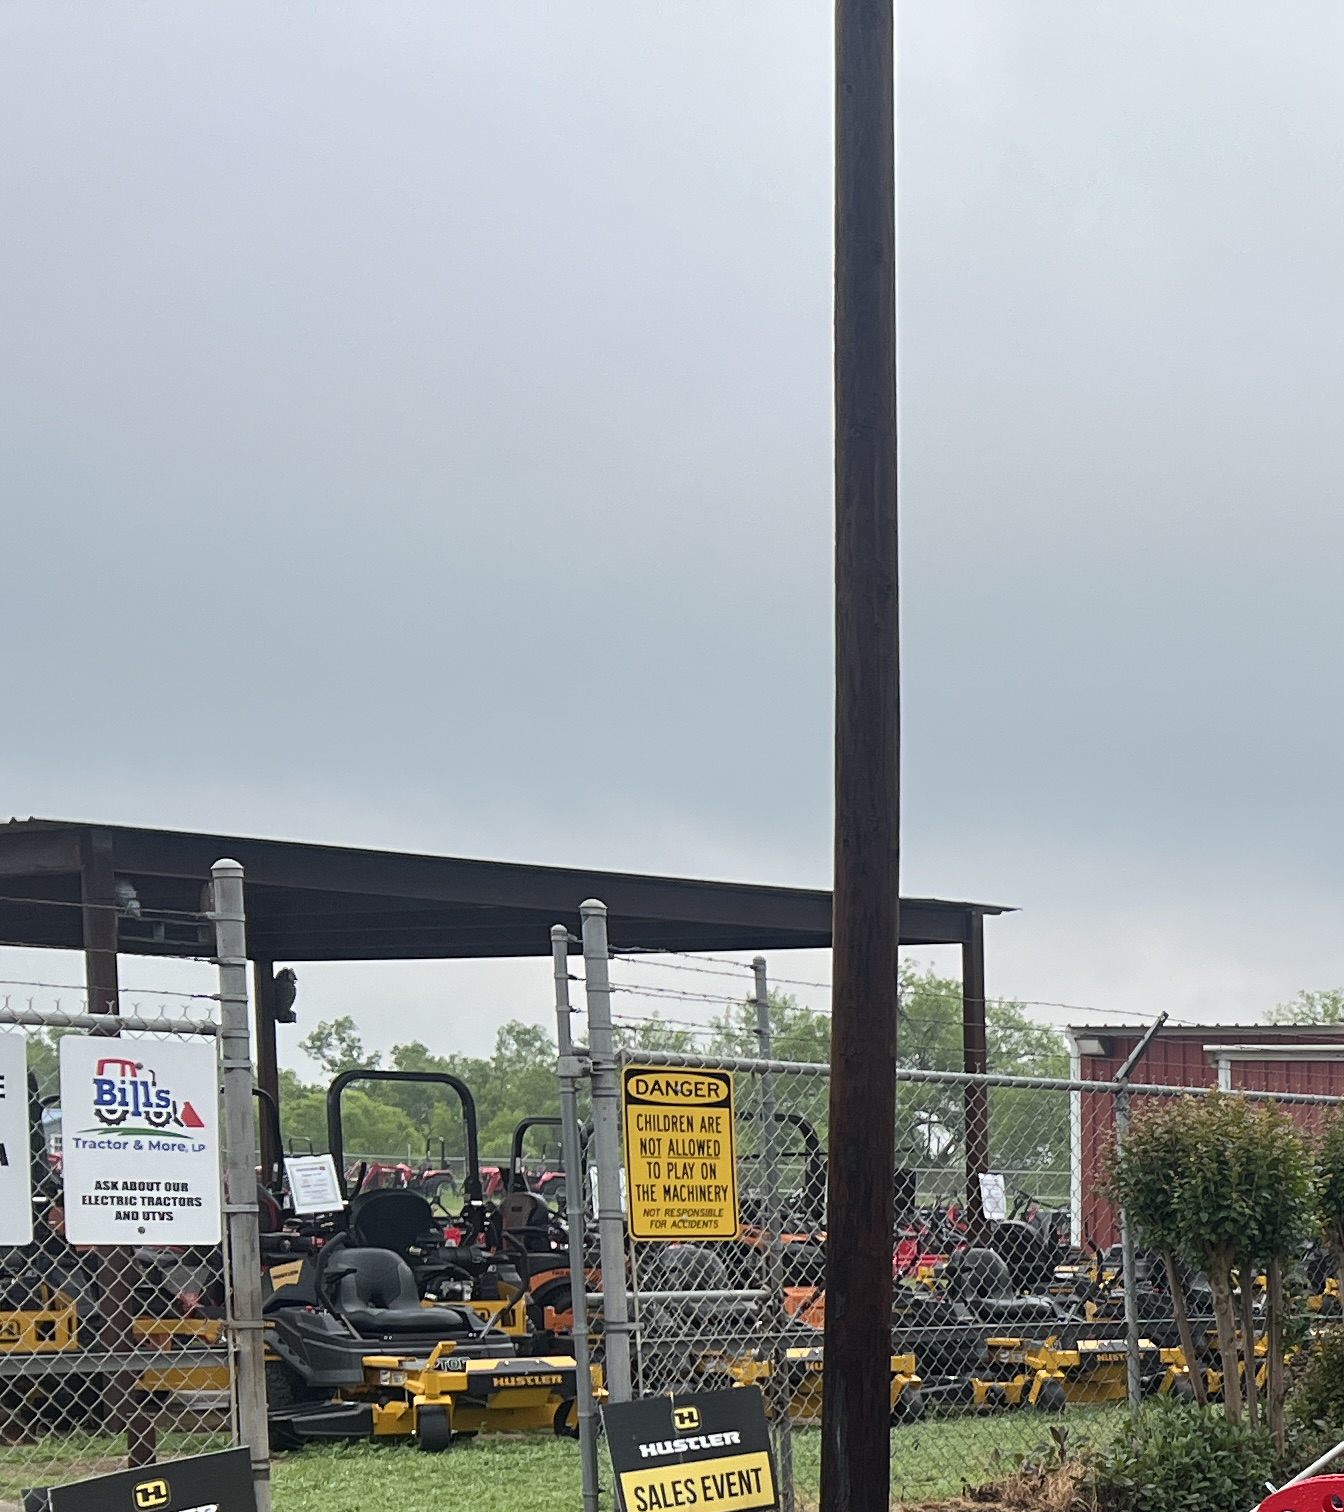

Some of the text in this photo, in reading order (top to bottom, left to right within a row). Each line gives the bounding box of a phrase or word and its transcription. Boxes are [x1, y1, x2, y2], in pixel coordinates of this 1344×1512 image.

[93, 1078, 171, 1117] Bill's
[636, 1079, 720, 1098] DANGER
[637, 1114, 722, 1134] CHILDREN ARE
[72, 1137, 206, 1153] Tractor & More, LP
[640, 1138, 721, 1158] NOT ALLOWED
[647, 1162, 717, 1180] TO PLAY ON
[94, 1180, 188, 1192] ASK ABOUT OUR
[635, 1184, 729, 1202] THE MACHINERY
[82, 1195, 202, 1207] ELECTRIC TRACTORS
[114, 1210, 139, 1221] AND
[643, 1208, 724, 1218] NOT RESPONSIBLE
[650, 1219, 719, 1229] FOR ACCIDENTS
[492, 1374, 563, 1387] HUSTLER
[638, 1430, 741, 1458] HUSTLER
[634, 1467, 762, 1512] SALES EVENT
